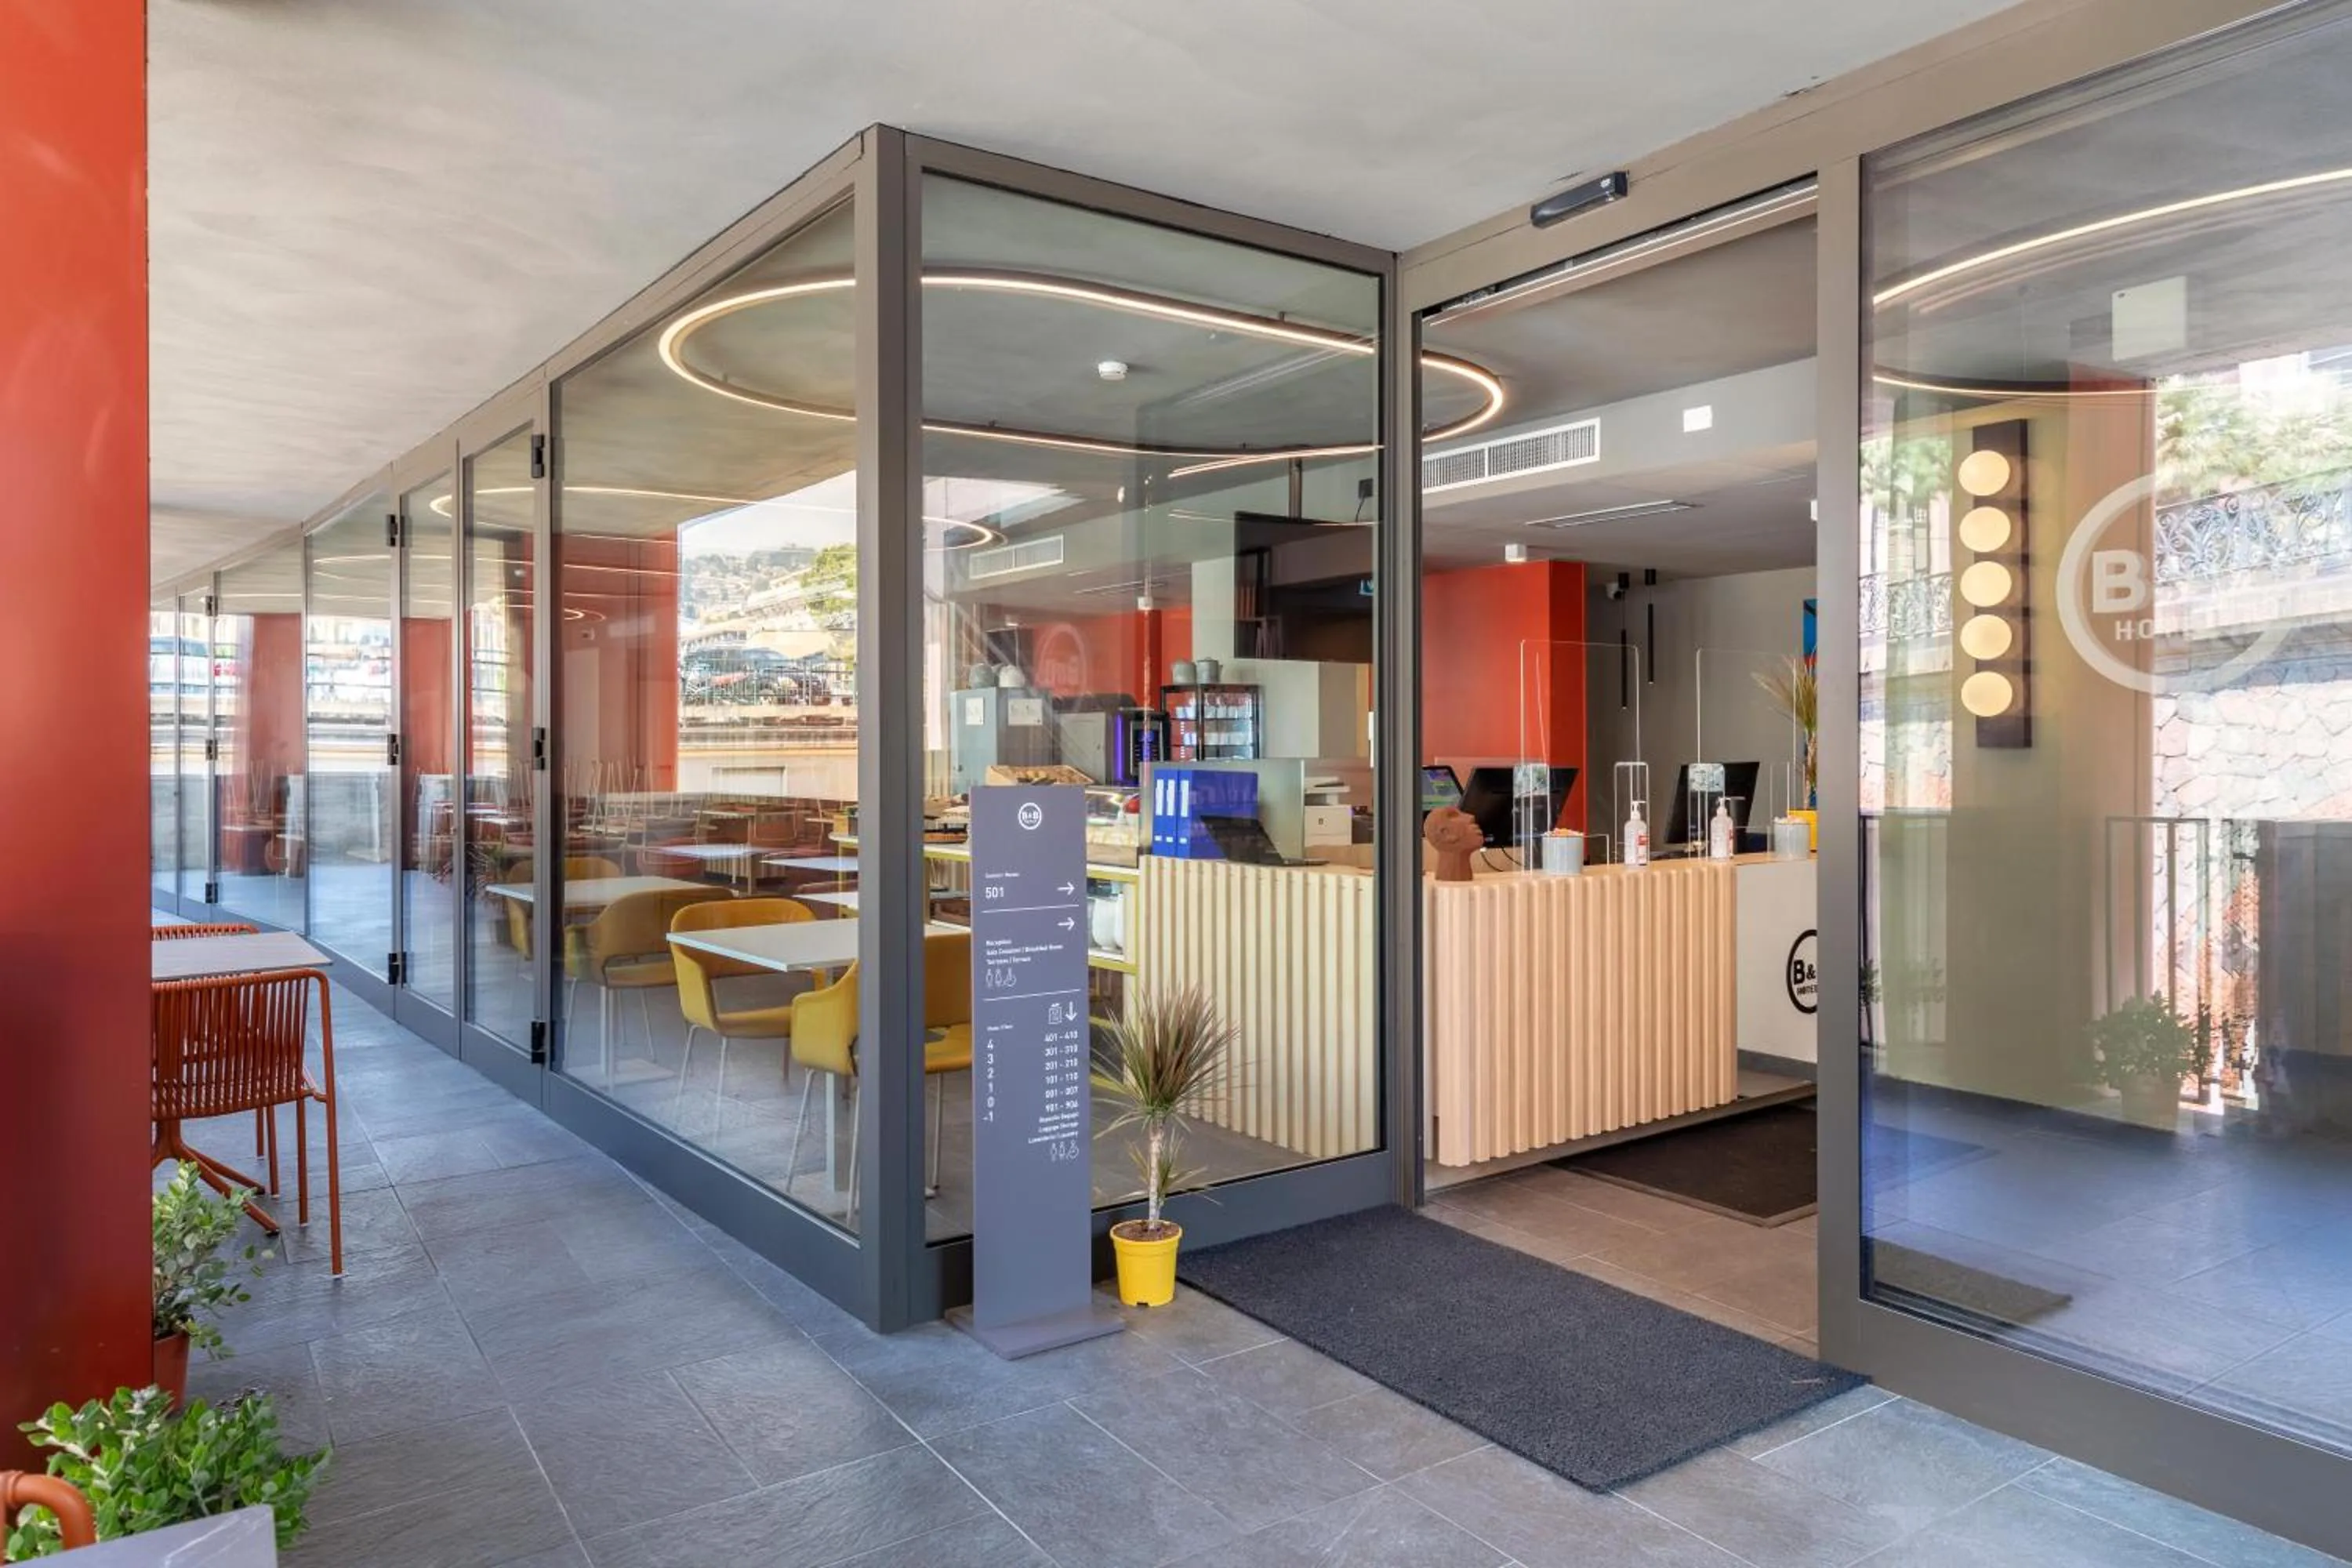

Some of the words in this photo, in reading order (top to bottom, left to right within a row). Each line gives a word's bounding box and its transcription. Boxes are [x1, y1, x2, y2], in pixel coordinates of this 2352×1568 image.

[985, 886, 1004, 899] 501
[1793, 959, 1817, 985] B&
[987, 1037, 994, 1050] 4
[987, 1053, 994, 1064] 3
[987, 1067, 994, 1079] 2
[989, 1081, 993, 1093] 1
[987, 1095, 995, 1109] 0
